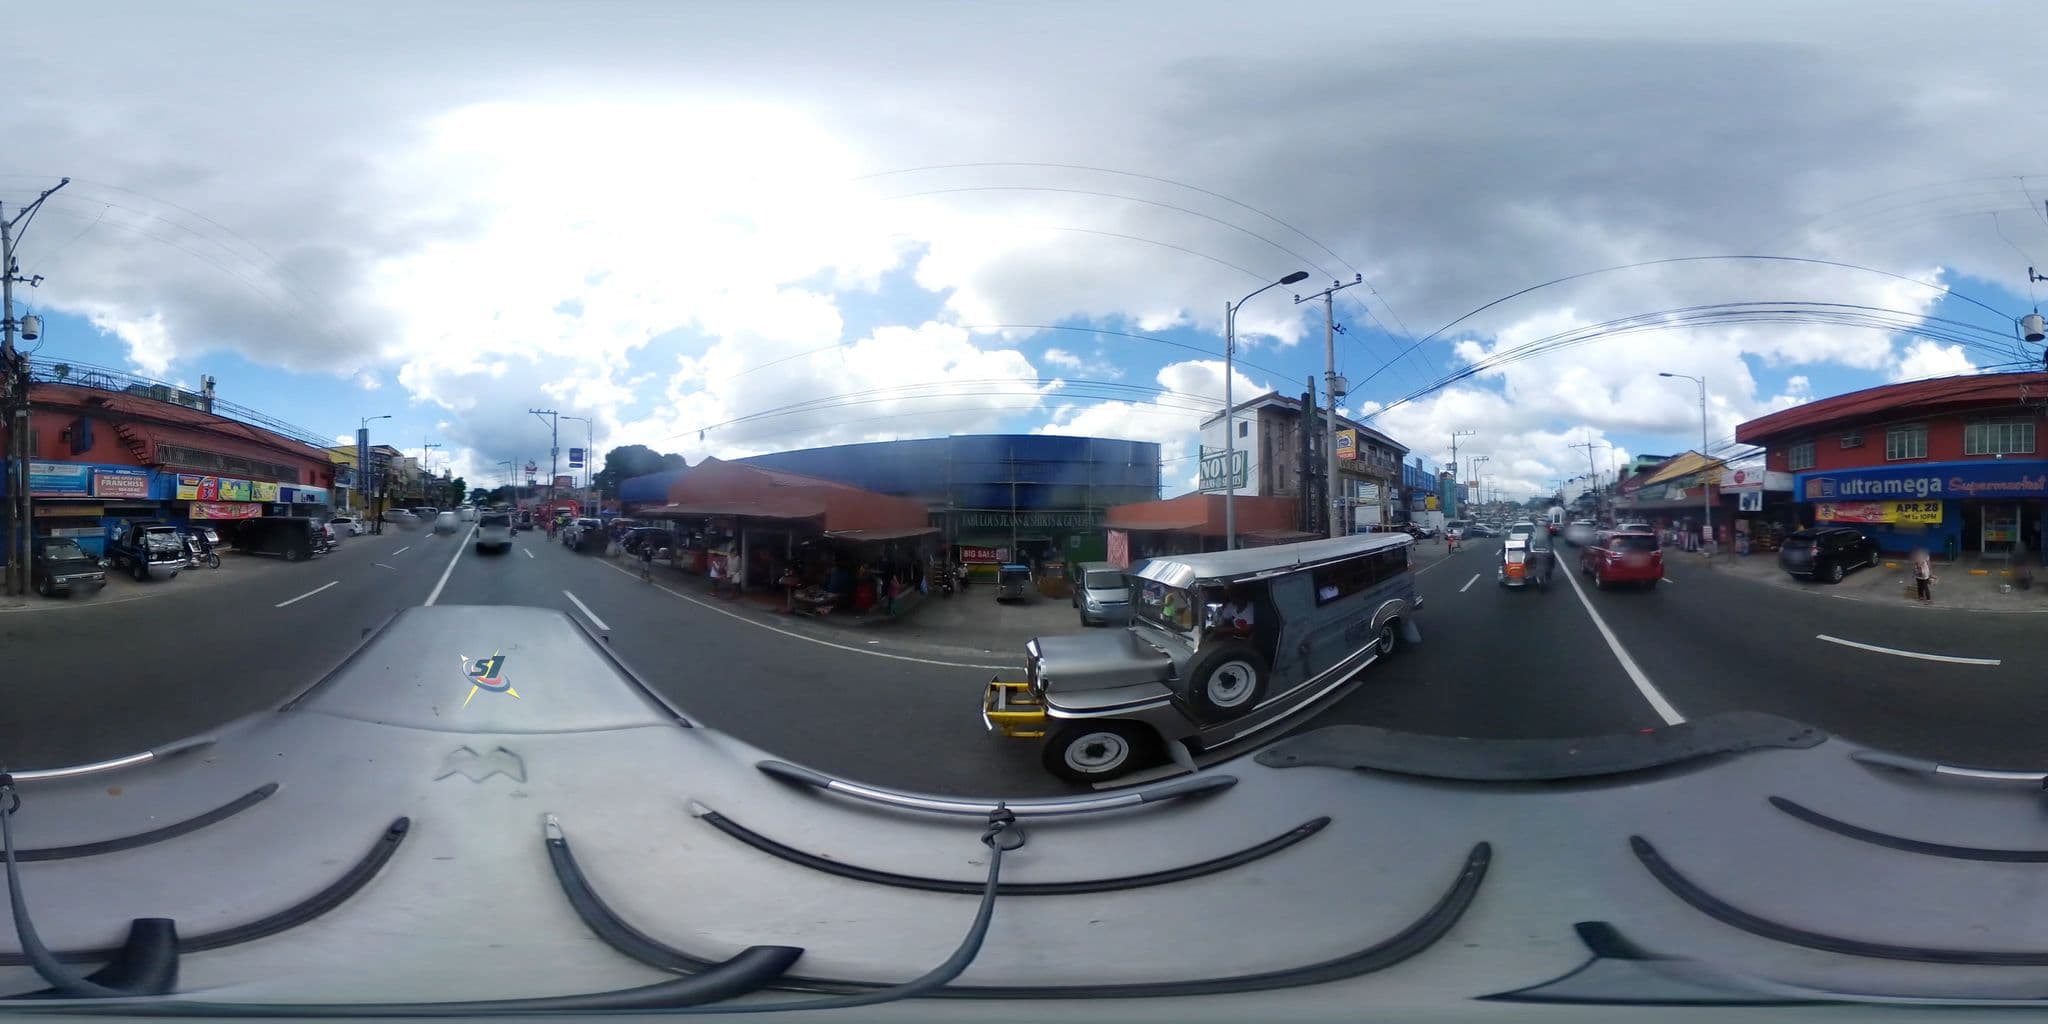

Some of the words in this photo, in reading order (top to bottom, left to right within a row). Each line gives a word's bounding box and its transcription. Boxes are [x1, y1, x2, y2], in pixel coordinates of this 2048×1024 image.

[1200, 454, 1241, 480] NOVO
[101, 479, 144, 488] FRANCHISE
[1841, 478, 1942, 498] ultramega
[1949, 475, 2046, 496] Supermarket
[1896, 503, 1922, 513] APR.
[1924, 503, 1939, 512] 28
[963, 549, 976, 558] BIG
